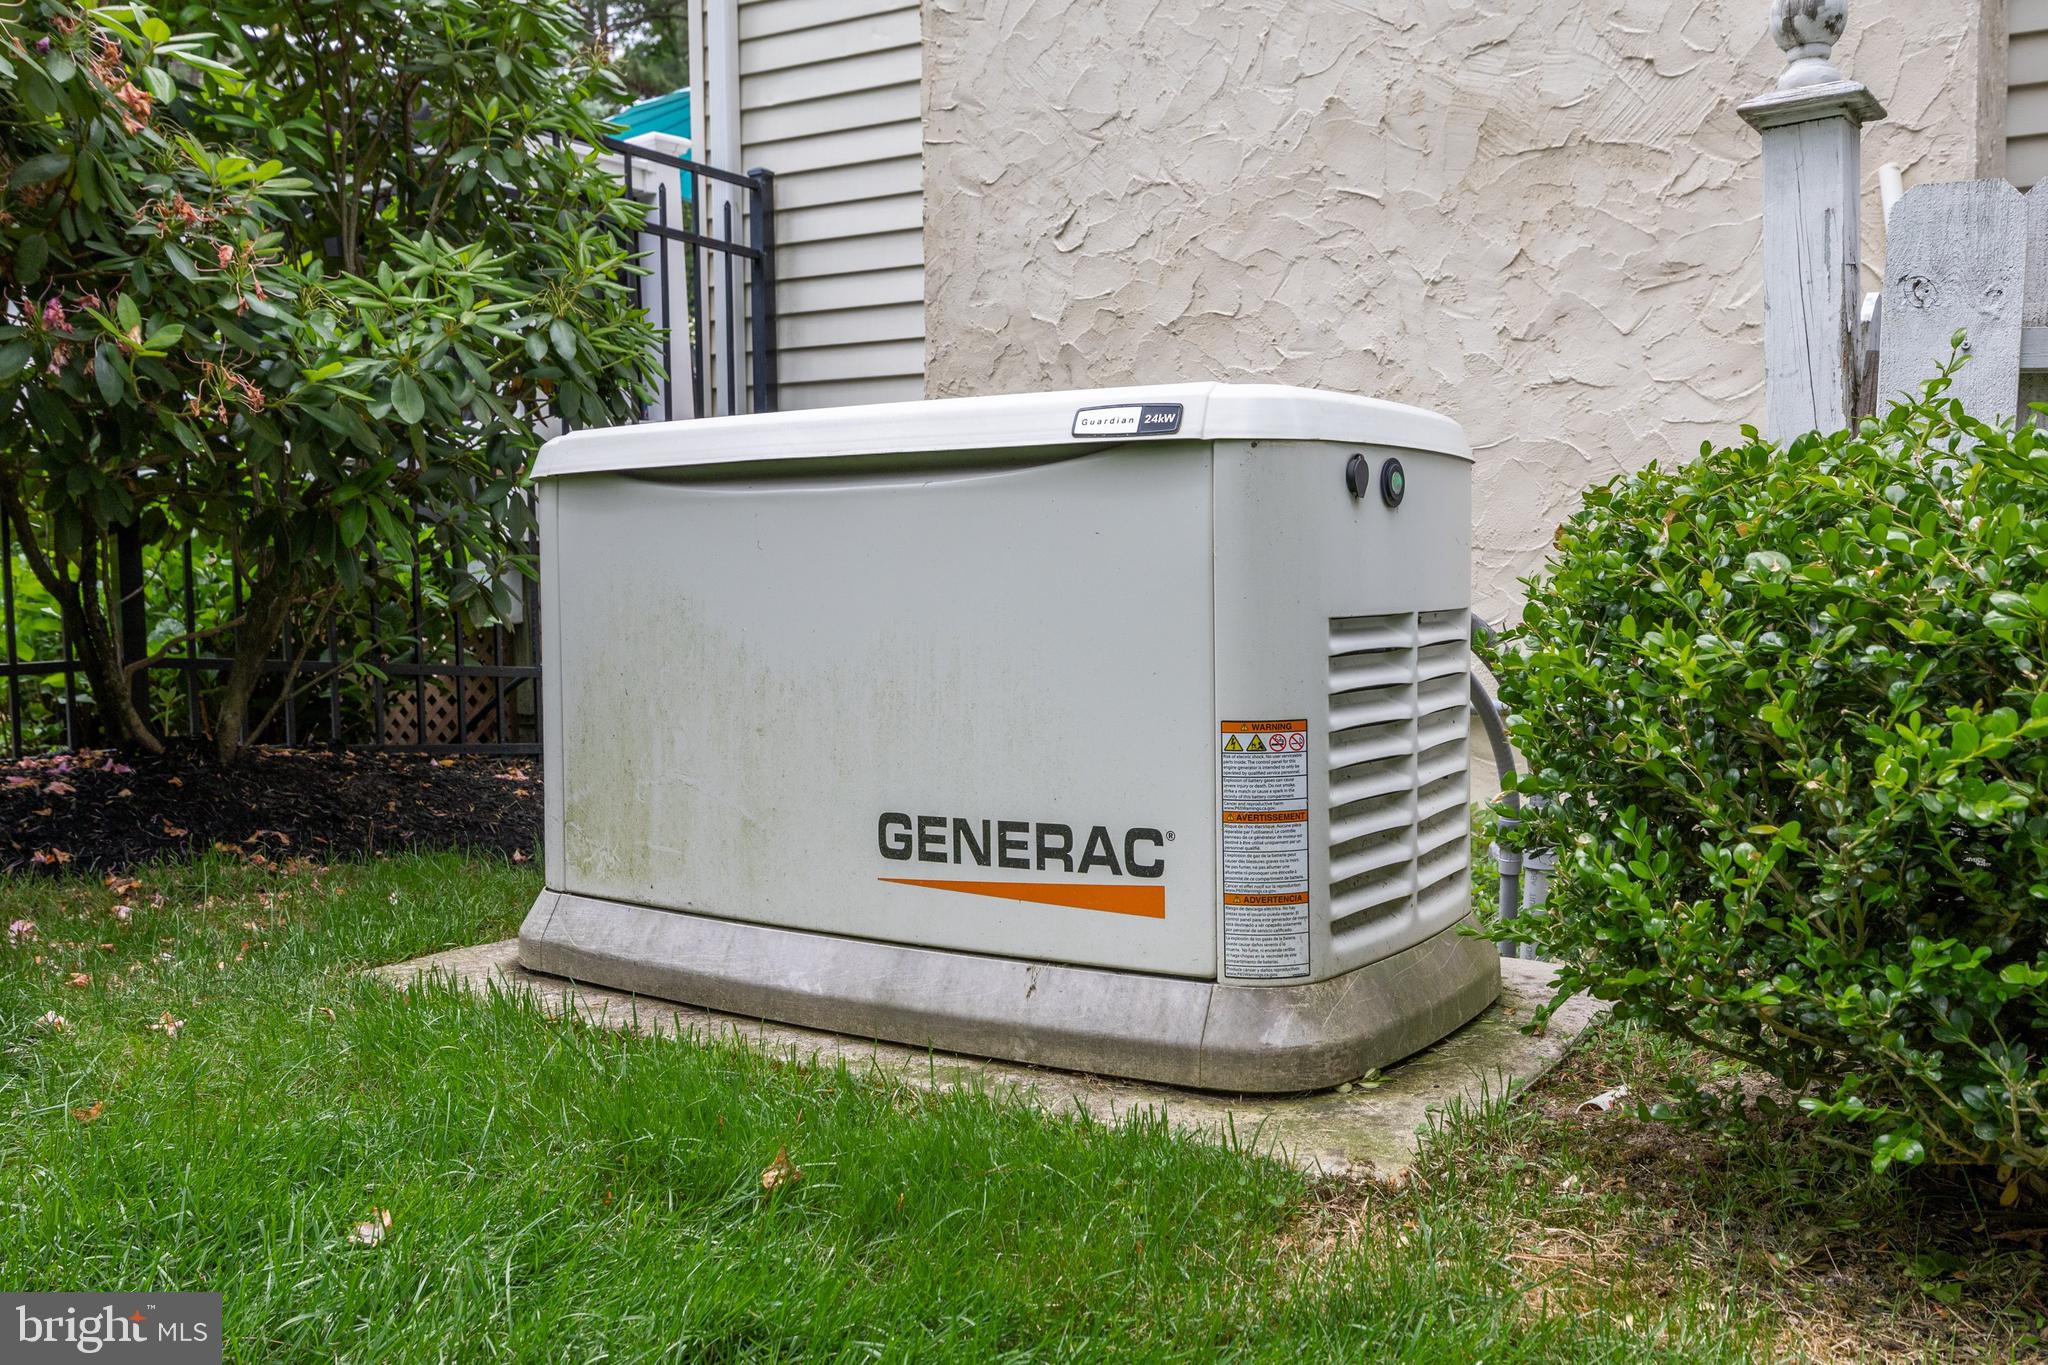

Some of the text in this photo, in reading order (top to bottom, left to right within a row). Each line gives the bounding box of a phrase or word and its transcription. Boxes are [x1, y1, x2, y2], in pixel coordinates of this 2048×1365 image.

[1081, 414, 1176, 426] Guardian 24kW
[1252, 723, 1292, 731] WARNING
[1236, 812, 1305, 821] AVERTISSEMENT
[1244, 895, 1302, 904] ADVERTENCIA
